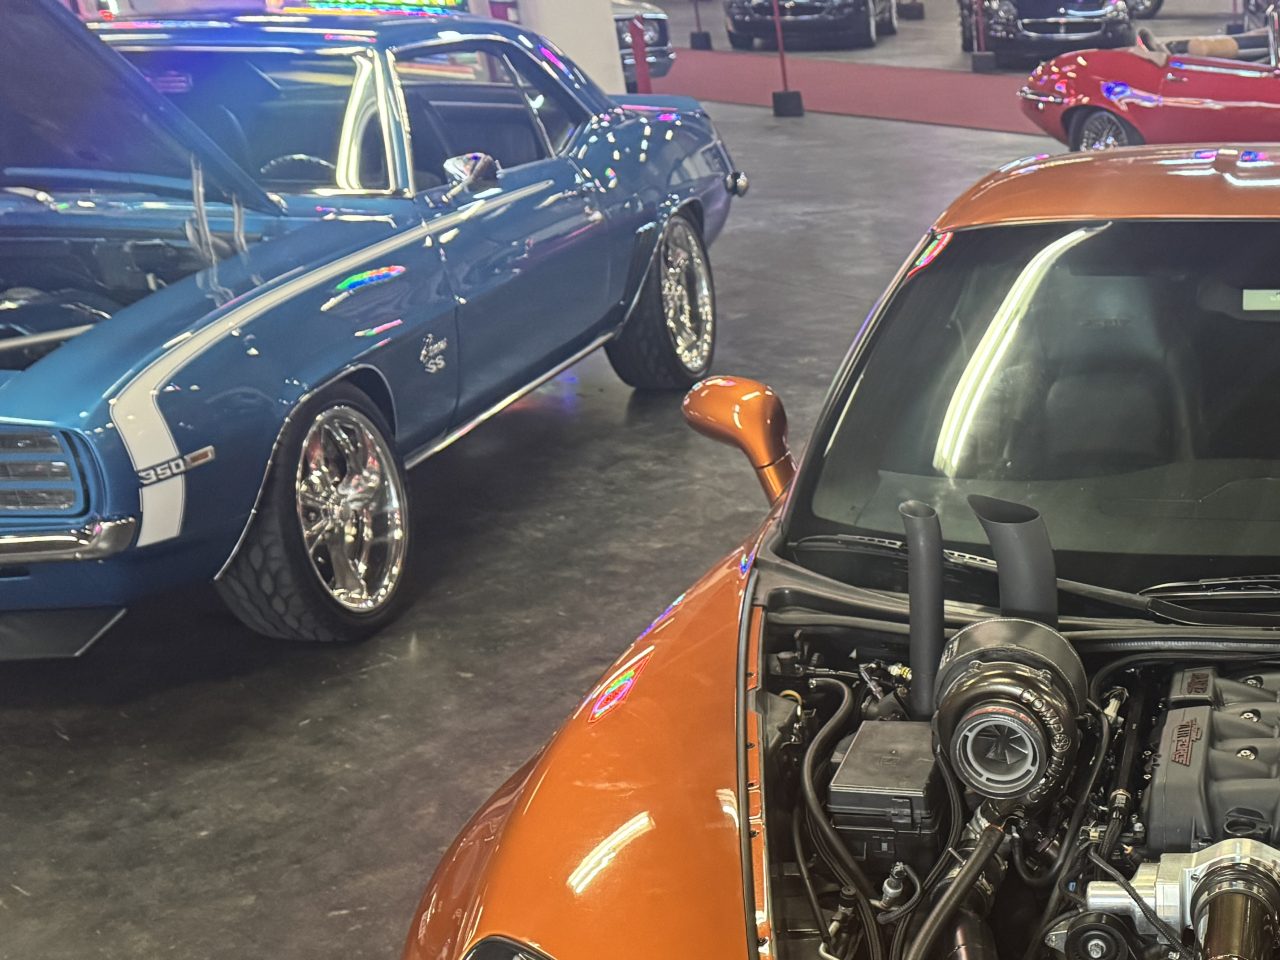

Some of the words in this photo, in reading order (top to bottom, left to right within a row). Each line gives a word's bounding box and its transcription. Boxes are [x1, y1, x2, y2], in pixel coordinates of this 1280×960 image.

[425, 354, 446, 373] SS
[138, 458, 184, 485] 350
[1021, 689, 1063, 733] COMP
